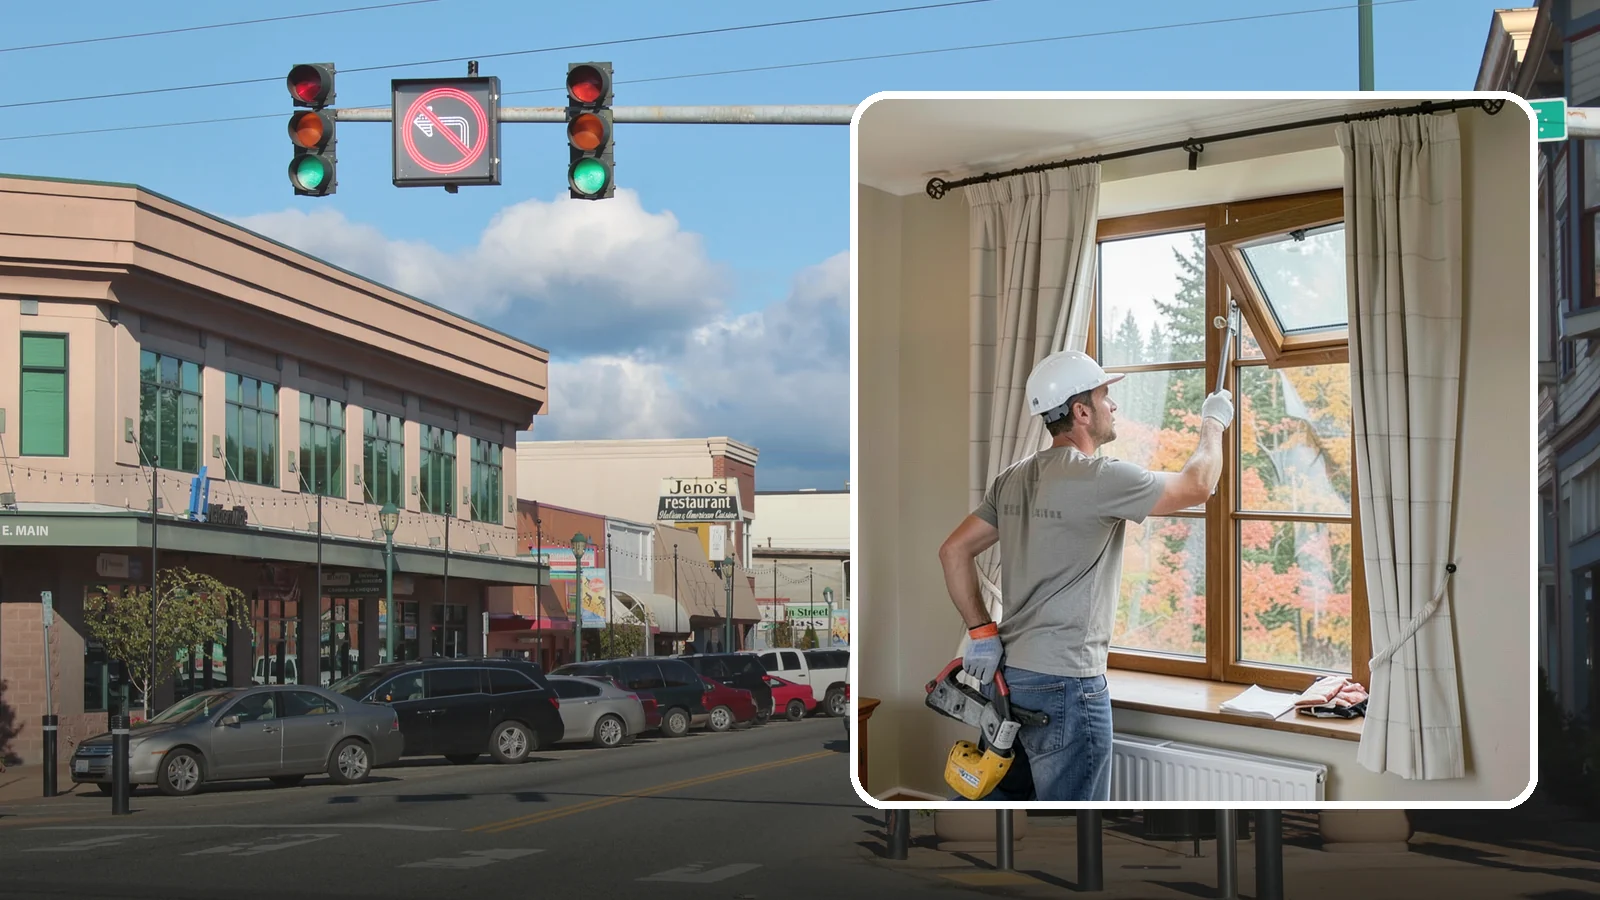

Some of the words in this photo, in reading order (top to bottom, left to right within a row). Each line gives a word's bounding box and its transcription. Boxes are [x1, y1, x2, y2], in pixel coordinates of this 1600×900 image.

[669, 480, 727, 495] Jeno's
[665, 496, 731, 509] restaurant
[658, 509, 681, 520] Italian
[686, 509, 714, 520] American
[714, 509, 738, 520] Cuisine
[2, 525, 13, 536] E.
[15, 525, 49, 536] MAIN
[797, 607, 828, 617] Street
[790, 619, 824, 628] lass
